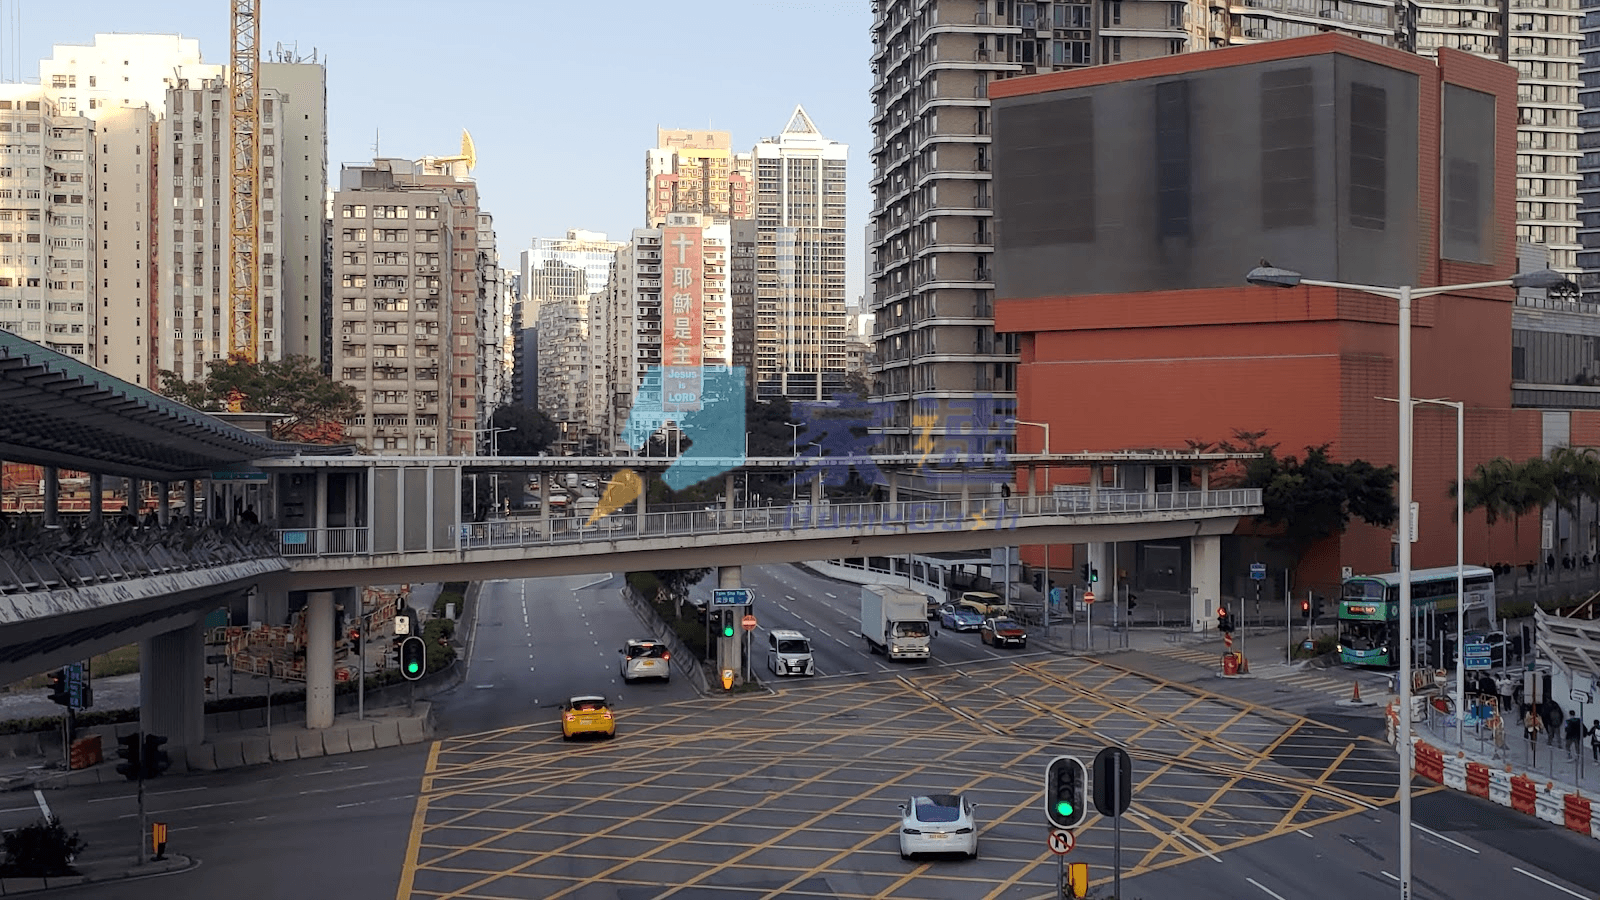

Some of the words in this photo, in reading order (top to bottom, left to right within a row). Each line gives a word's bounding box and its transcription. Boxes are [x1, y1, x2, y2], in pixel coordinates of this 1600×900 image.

[668, 369, 697, 379] Jesus
[678, 381, 686, 390] is
[668, 392, 697, 402] LORD
